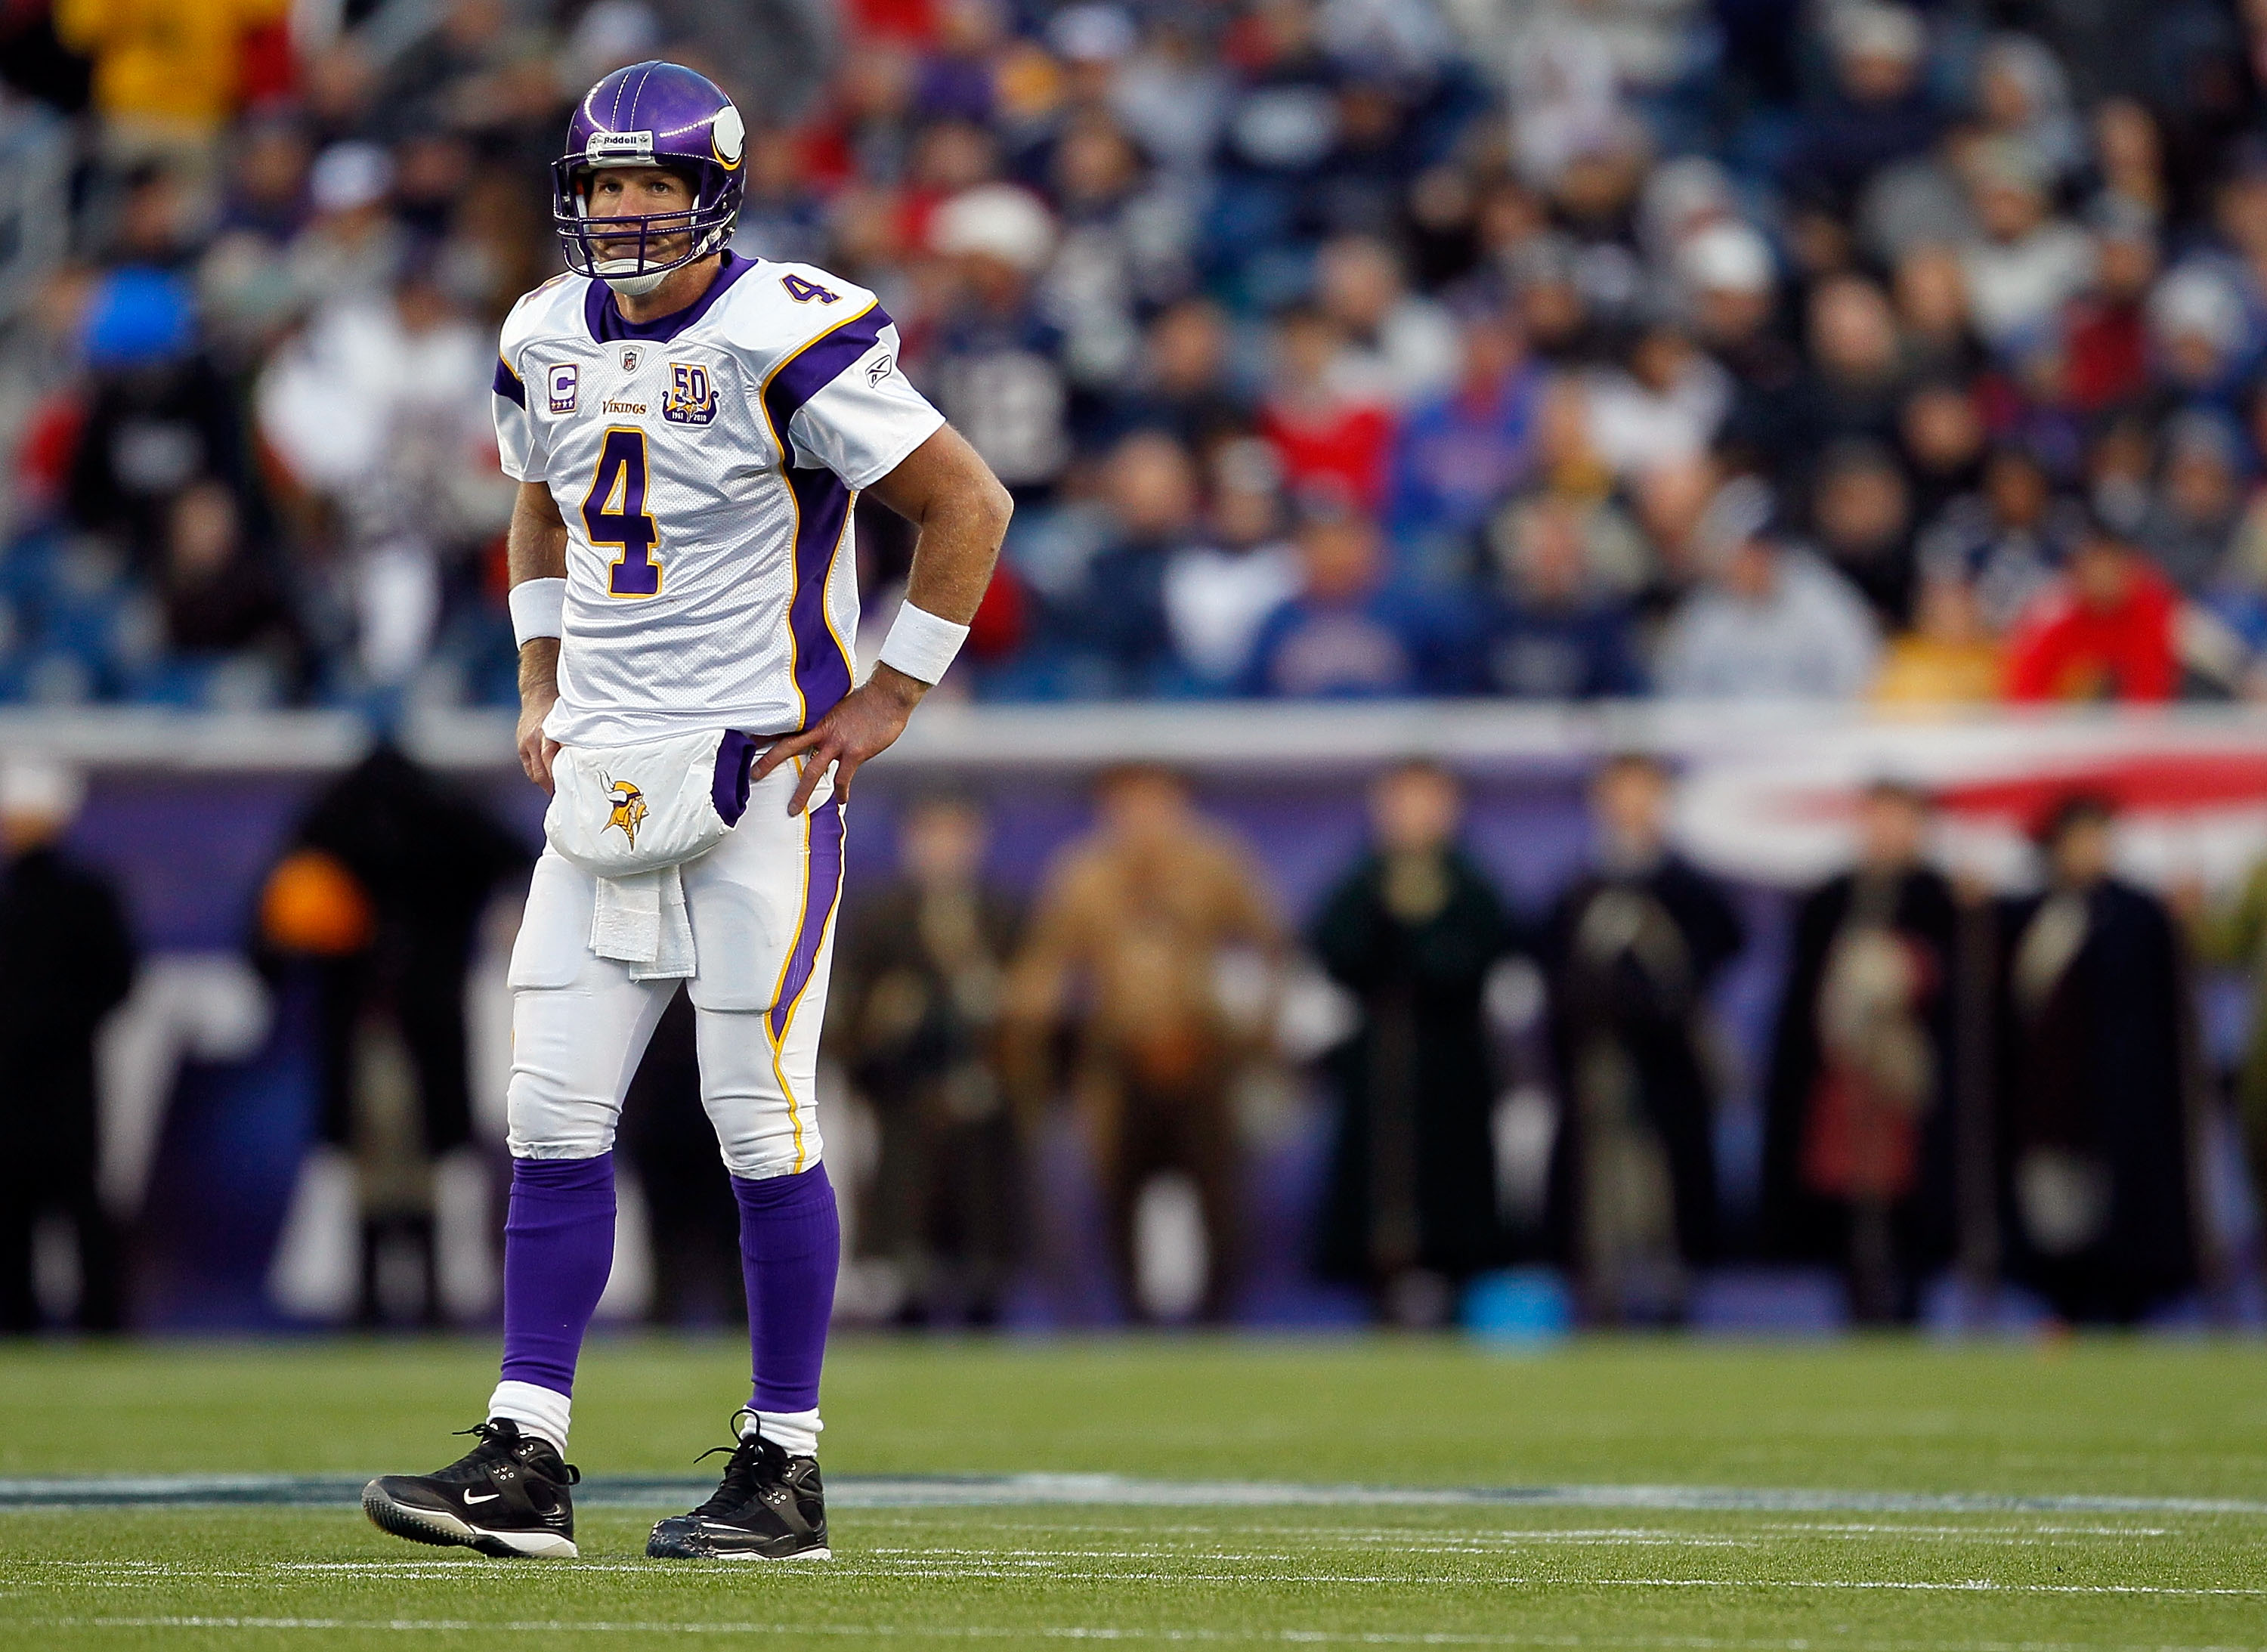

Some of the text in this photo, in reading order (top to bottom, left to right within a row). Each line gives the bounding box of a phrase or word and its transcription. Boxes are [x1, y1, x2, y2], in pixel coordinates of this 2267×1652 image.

[779, 273, 843, 306] 4
[549, 366, 577, 401] C
[674, 368, 707, 404] 50
[693, 413, 707, 422] 2010
[580, 426, 663, 599] 4
